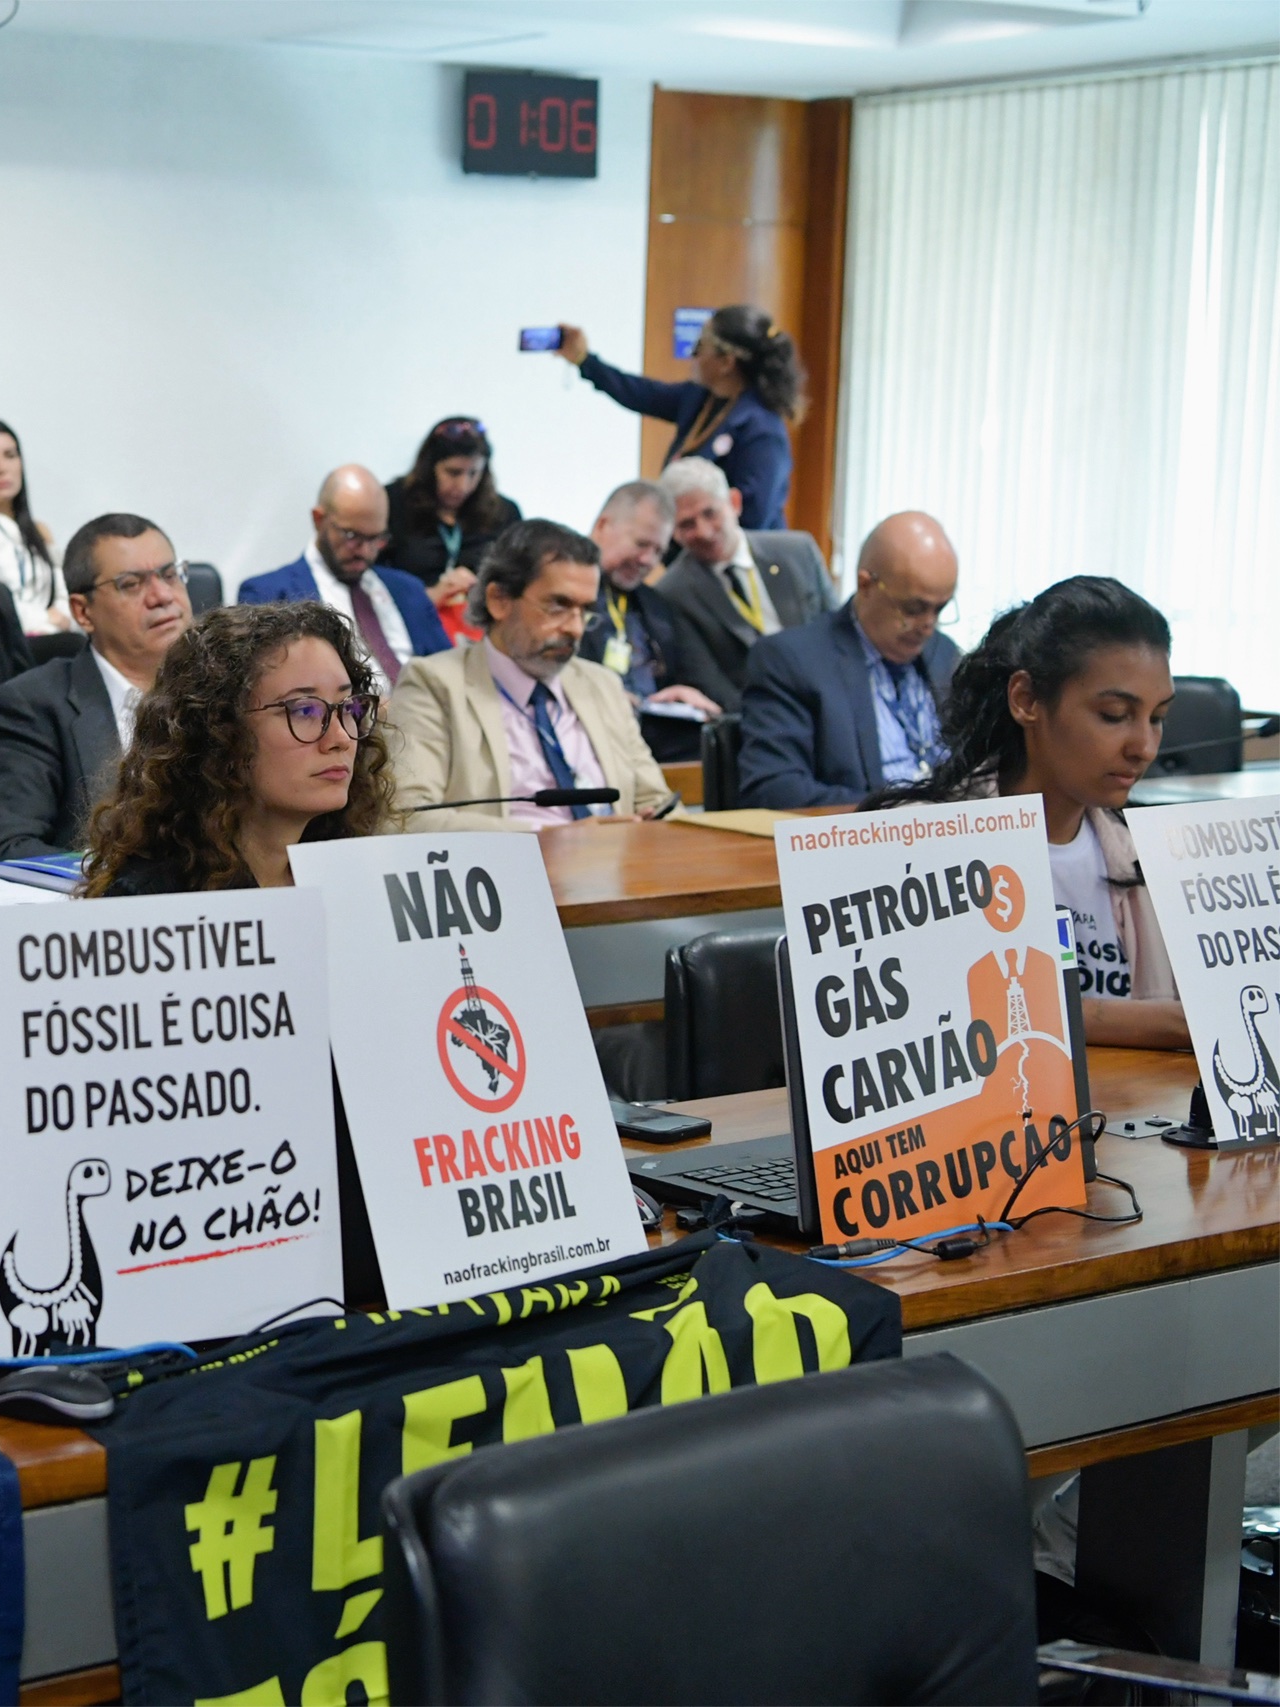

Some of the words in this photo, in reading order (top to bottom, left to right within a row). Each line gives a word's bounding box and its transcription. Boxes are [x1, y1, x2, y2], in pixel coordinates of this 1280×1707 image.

[790, 808, 1038, 853] naofrackingbrasil.com.br
[1166, 811, 1280, 861] COMBUST
[382, 849, 502, 942] NÃO
[802, 859, 993, 956] PETRÓLEO
[1180, 872, 1270, 915] FÓSSIL
[19, 916, 275, 981] COMBUSTÍVEL
[1197, 930, 1234, 969] DO
[23, 1000, 152, 1058] FÓSSIL
[163, 992, 185, 1045] É
[192, 992, 295, 1044] COISA
[815, 949, 909, 1039] GÁS
[821, 1011, 999, 1124] CARVÃO
[27, 1084, 74, 1135] DO
[86, 1068, 261, 1130] PASSADO.
[125, 1140, 298, 1201] DEIXE-O
[413, 1114, 582, 1187] FRACKING
[833, 1147, 885, 1180] AQUI
[889, 1124, 927, 1160] TEM
[833, 1112, 1073, 1238] CORRUPÇÃO
[130, 1220, 187, 1256] NO
[204, 1187, 320, 1241] CHÃO!
[457, 1170, 577, 1238] BRASIL
[442, 1237, 612, 1286] naofrackingbrasil.com.br
